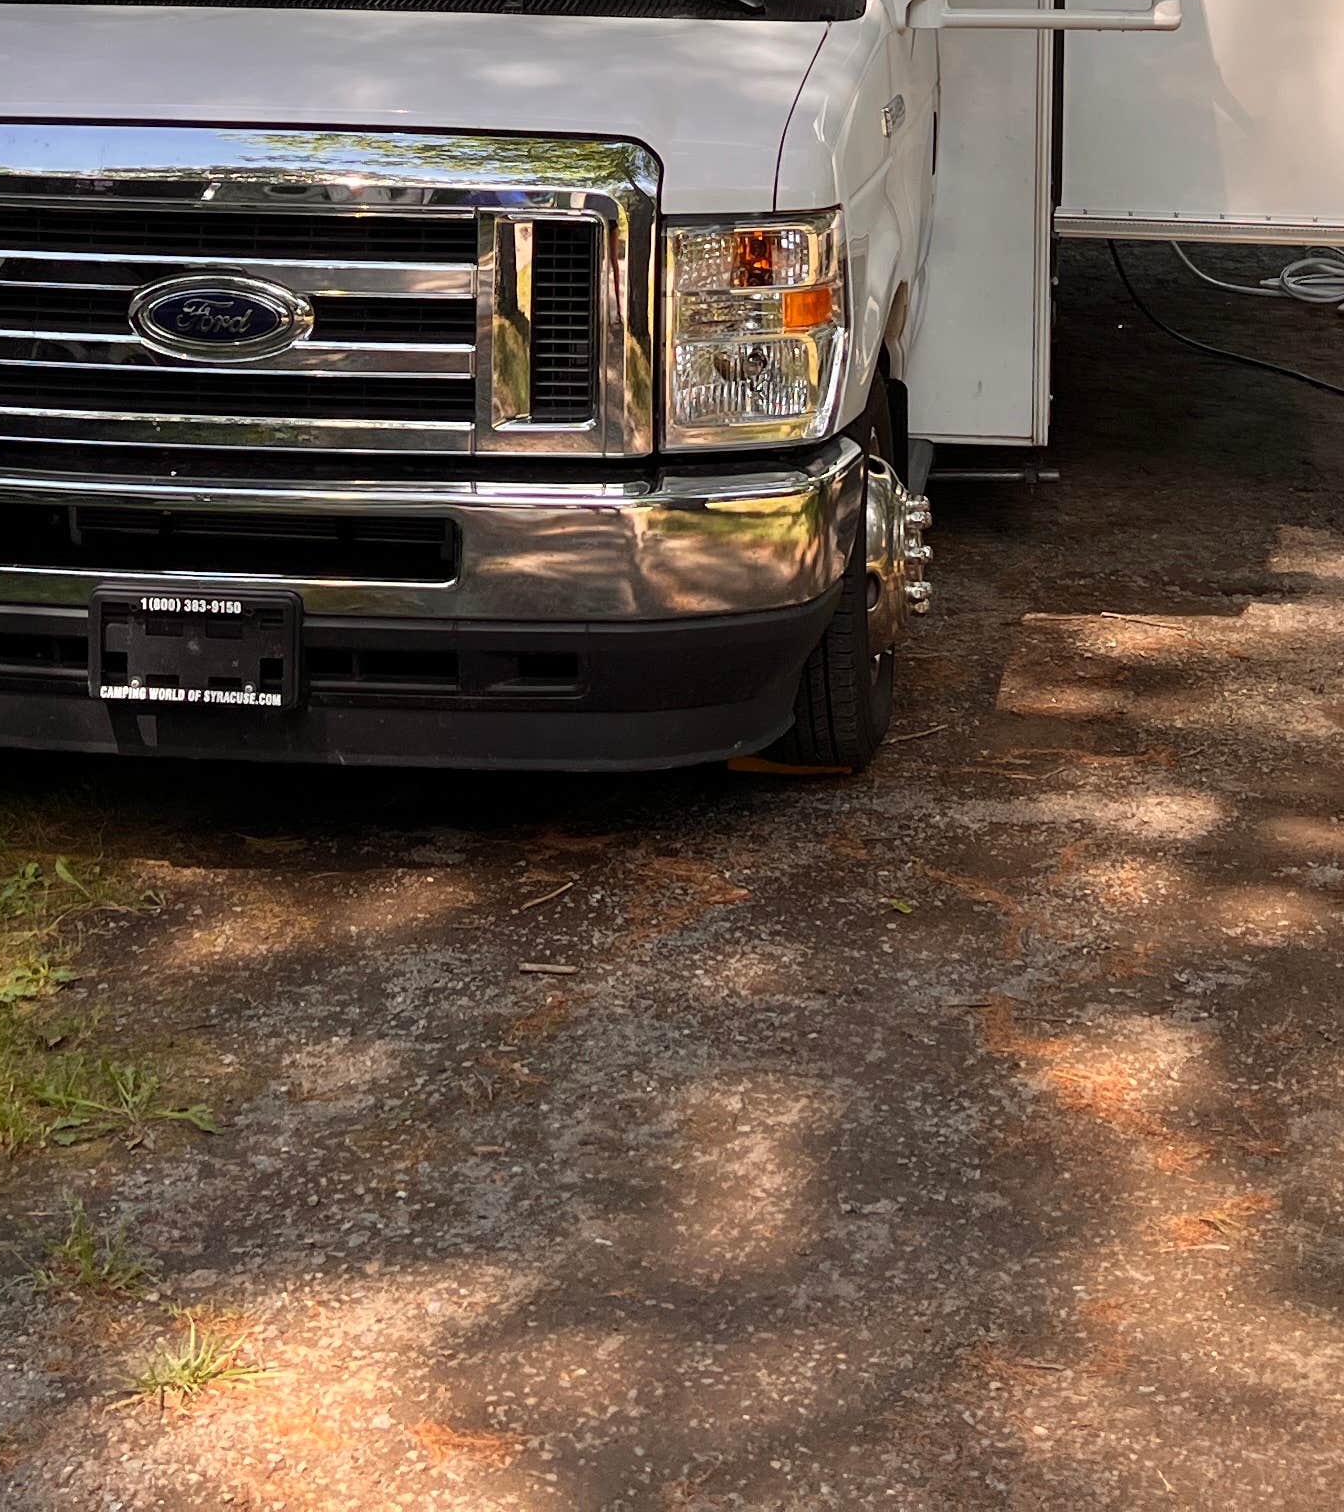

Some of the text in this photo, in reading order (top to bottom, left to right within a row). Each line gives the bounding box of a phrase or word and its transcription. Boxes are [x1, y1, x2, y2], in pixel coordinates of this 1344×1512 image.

[175, 297, 254, 334] Ford
[100, 685, 282, 707] CAMPING WORLD OF SYRACUSE.COM
